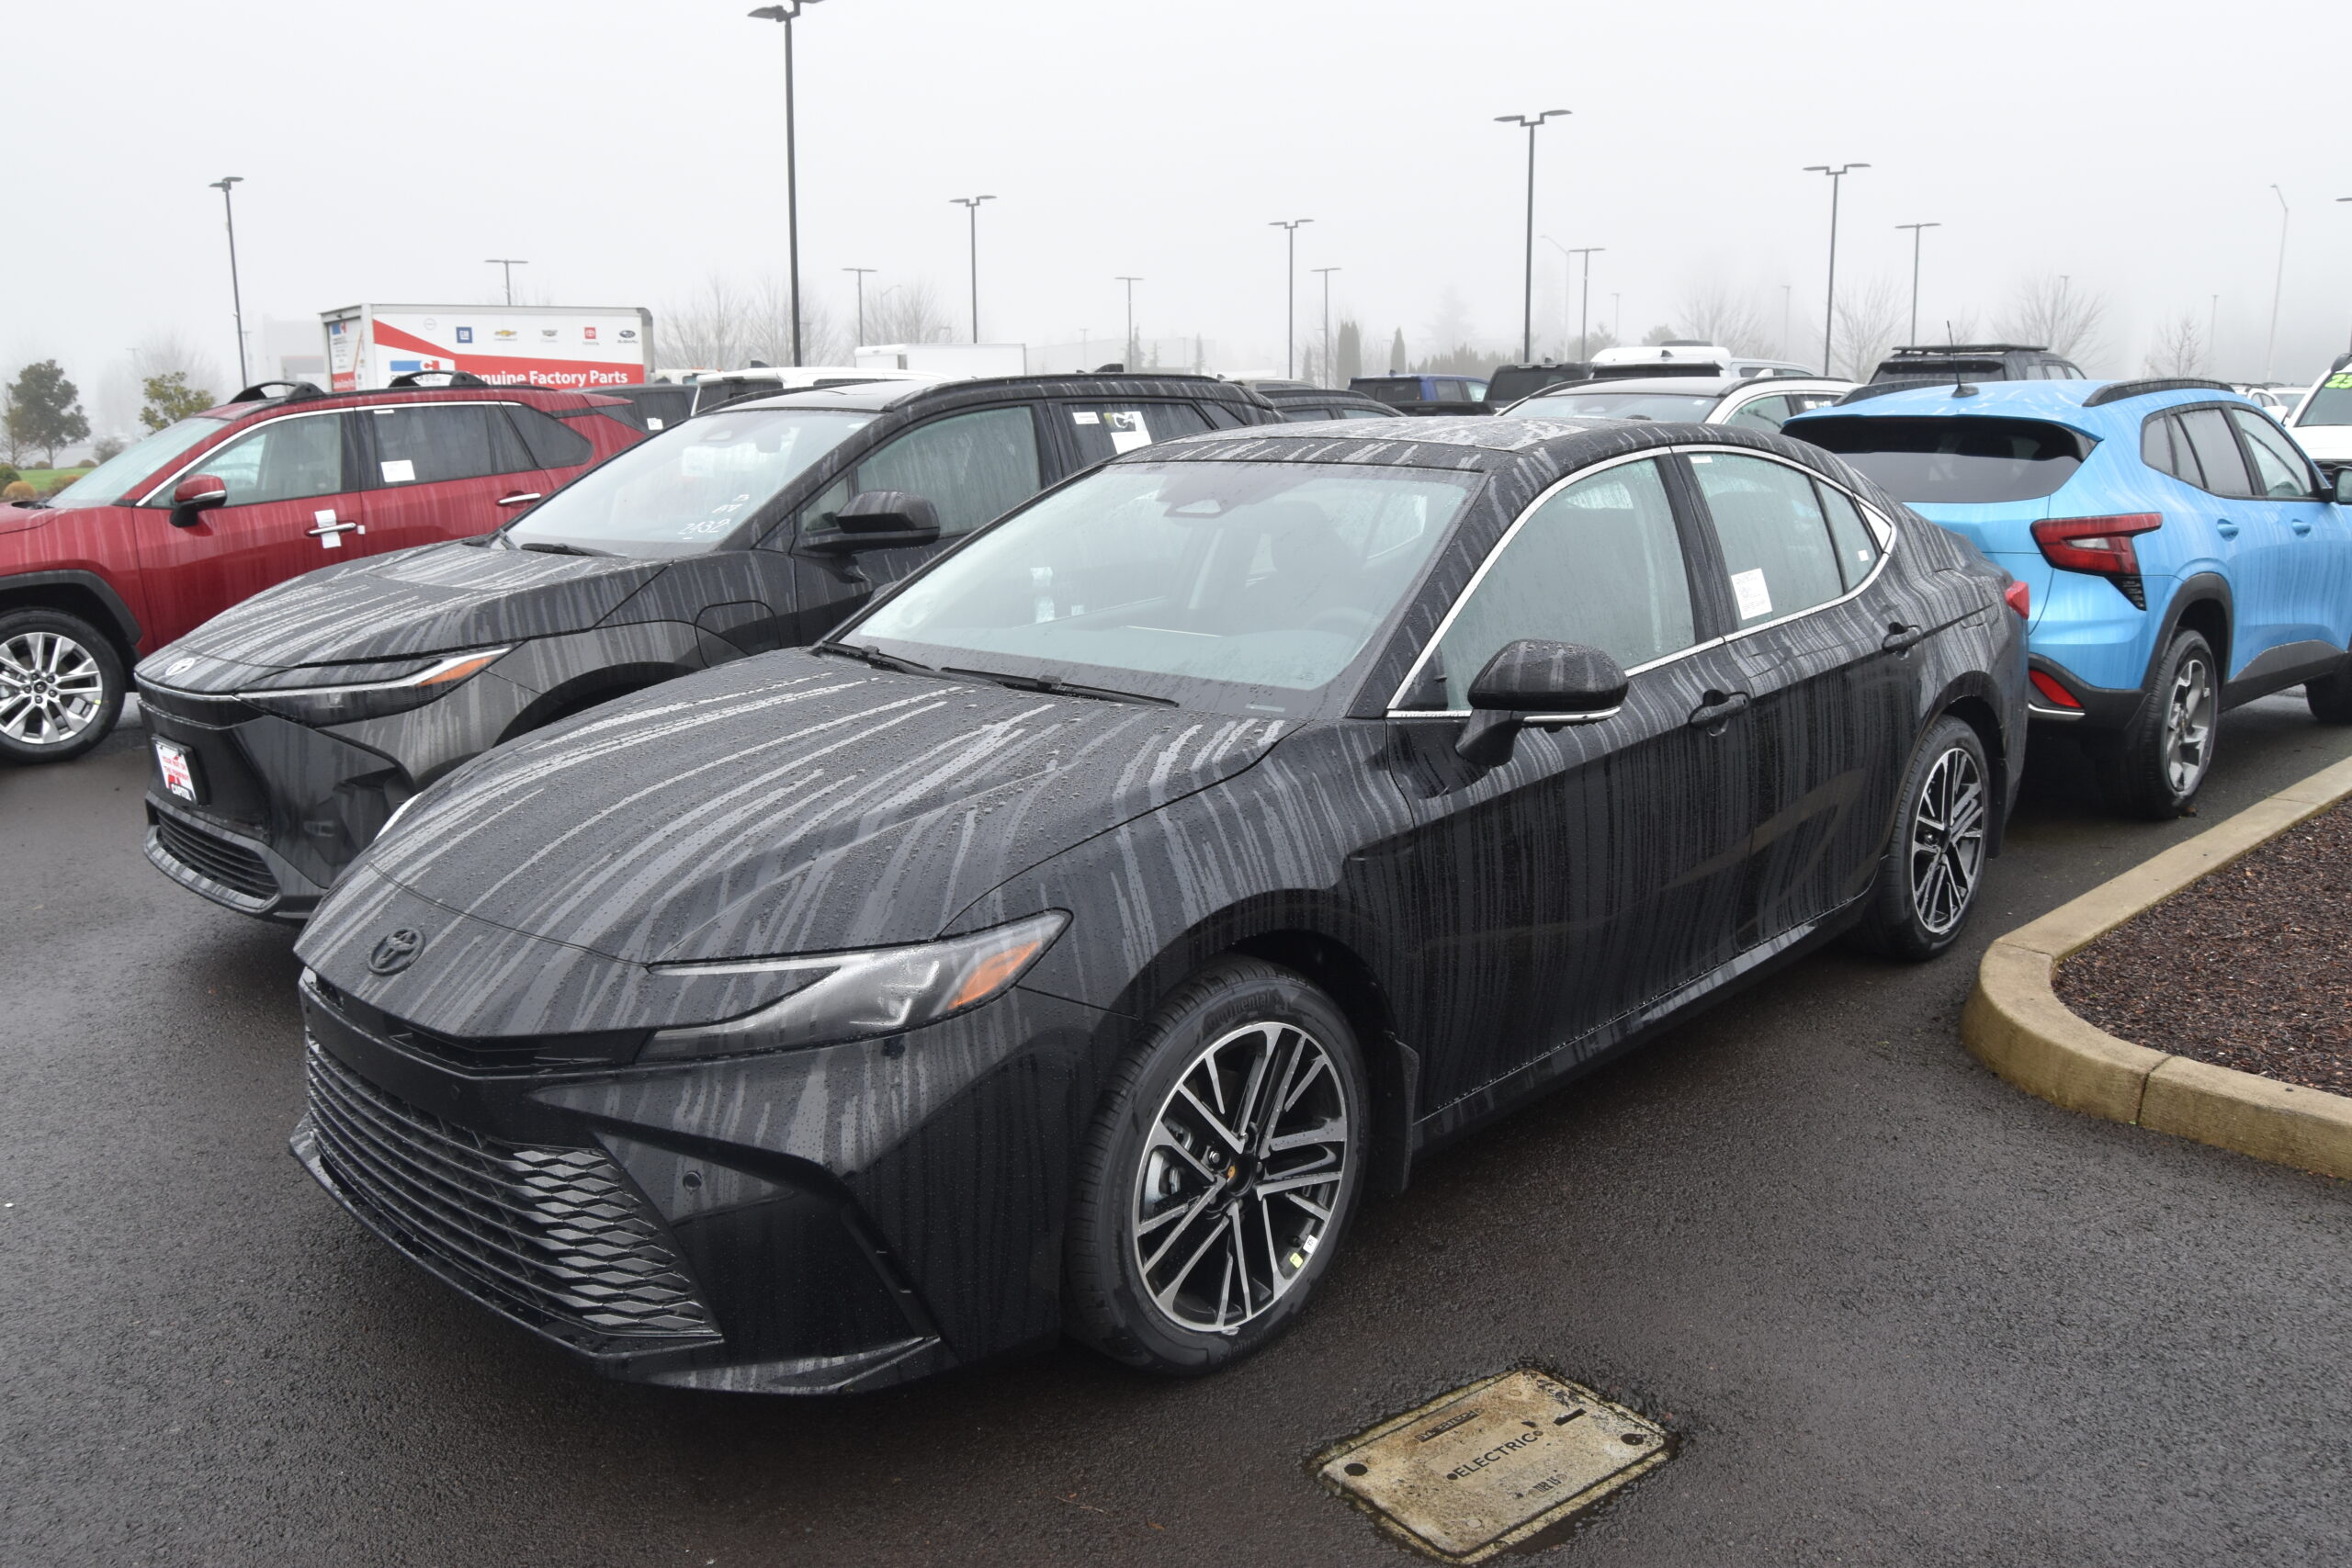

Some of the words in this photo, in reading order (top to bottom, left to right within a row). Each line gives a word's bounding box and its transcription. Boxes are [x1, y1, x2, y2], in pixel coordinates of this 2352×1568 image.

[467, 371, 526, 385] nuine
[529, 370, 586, 387] Factory
[590, 370, 628, 384] Parts
[1453, 1432, 1538, 1478] ELECTRIC
[1546, 1475, 1562, 1486] 15
